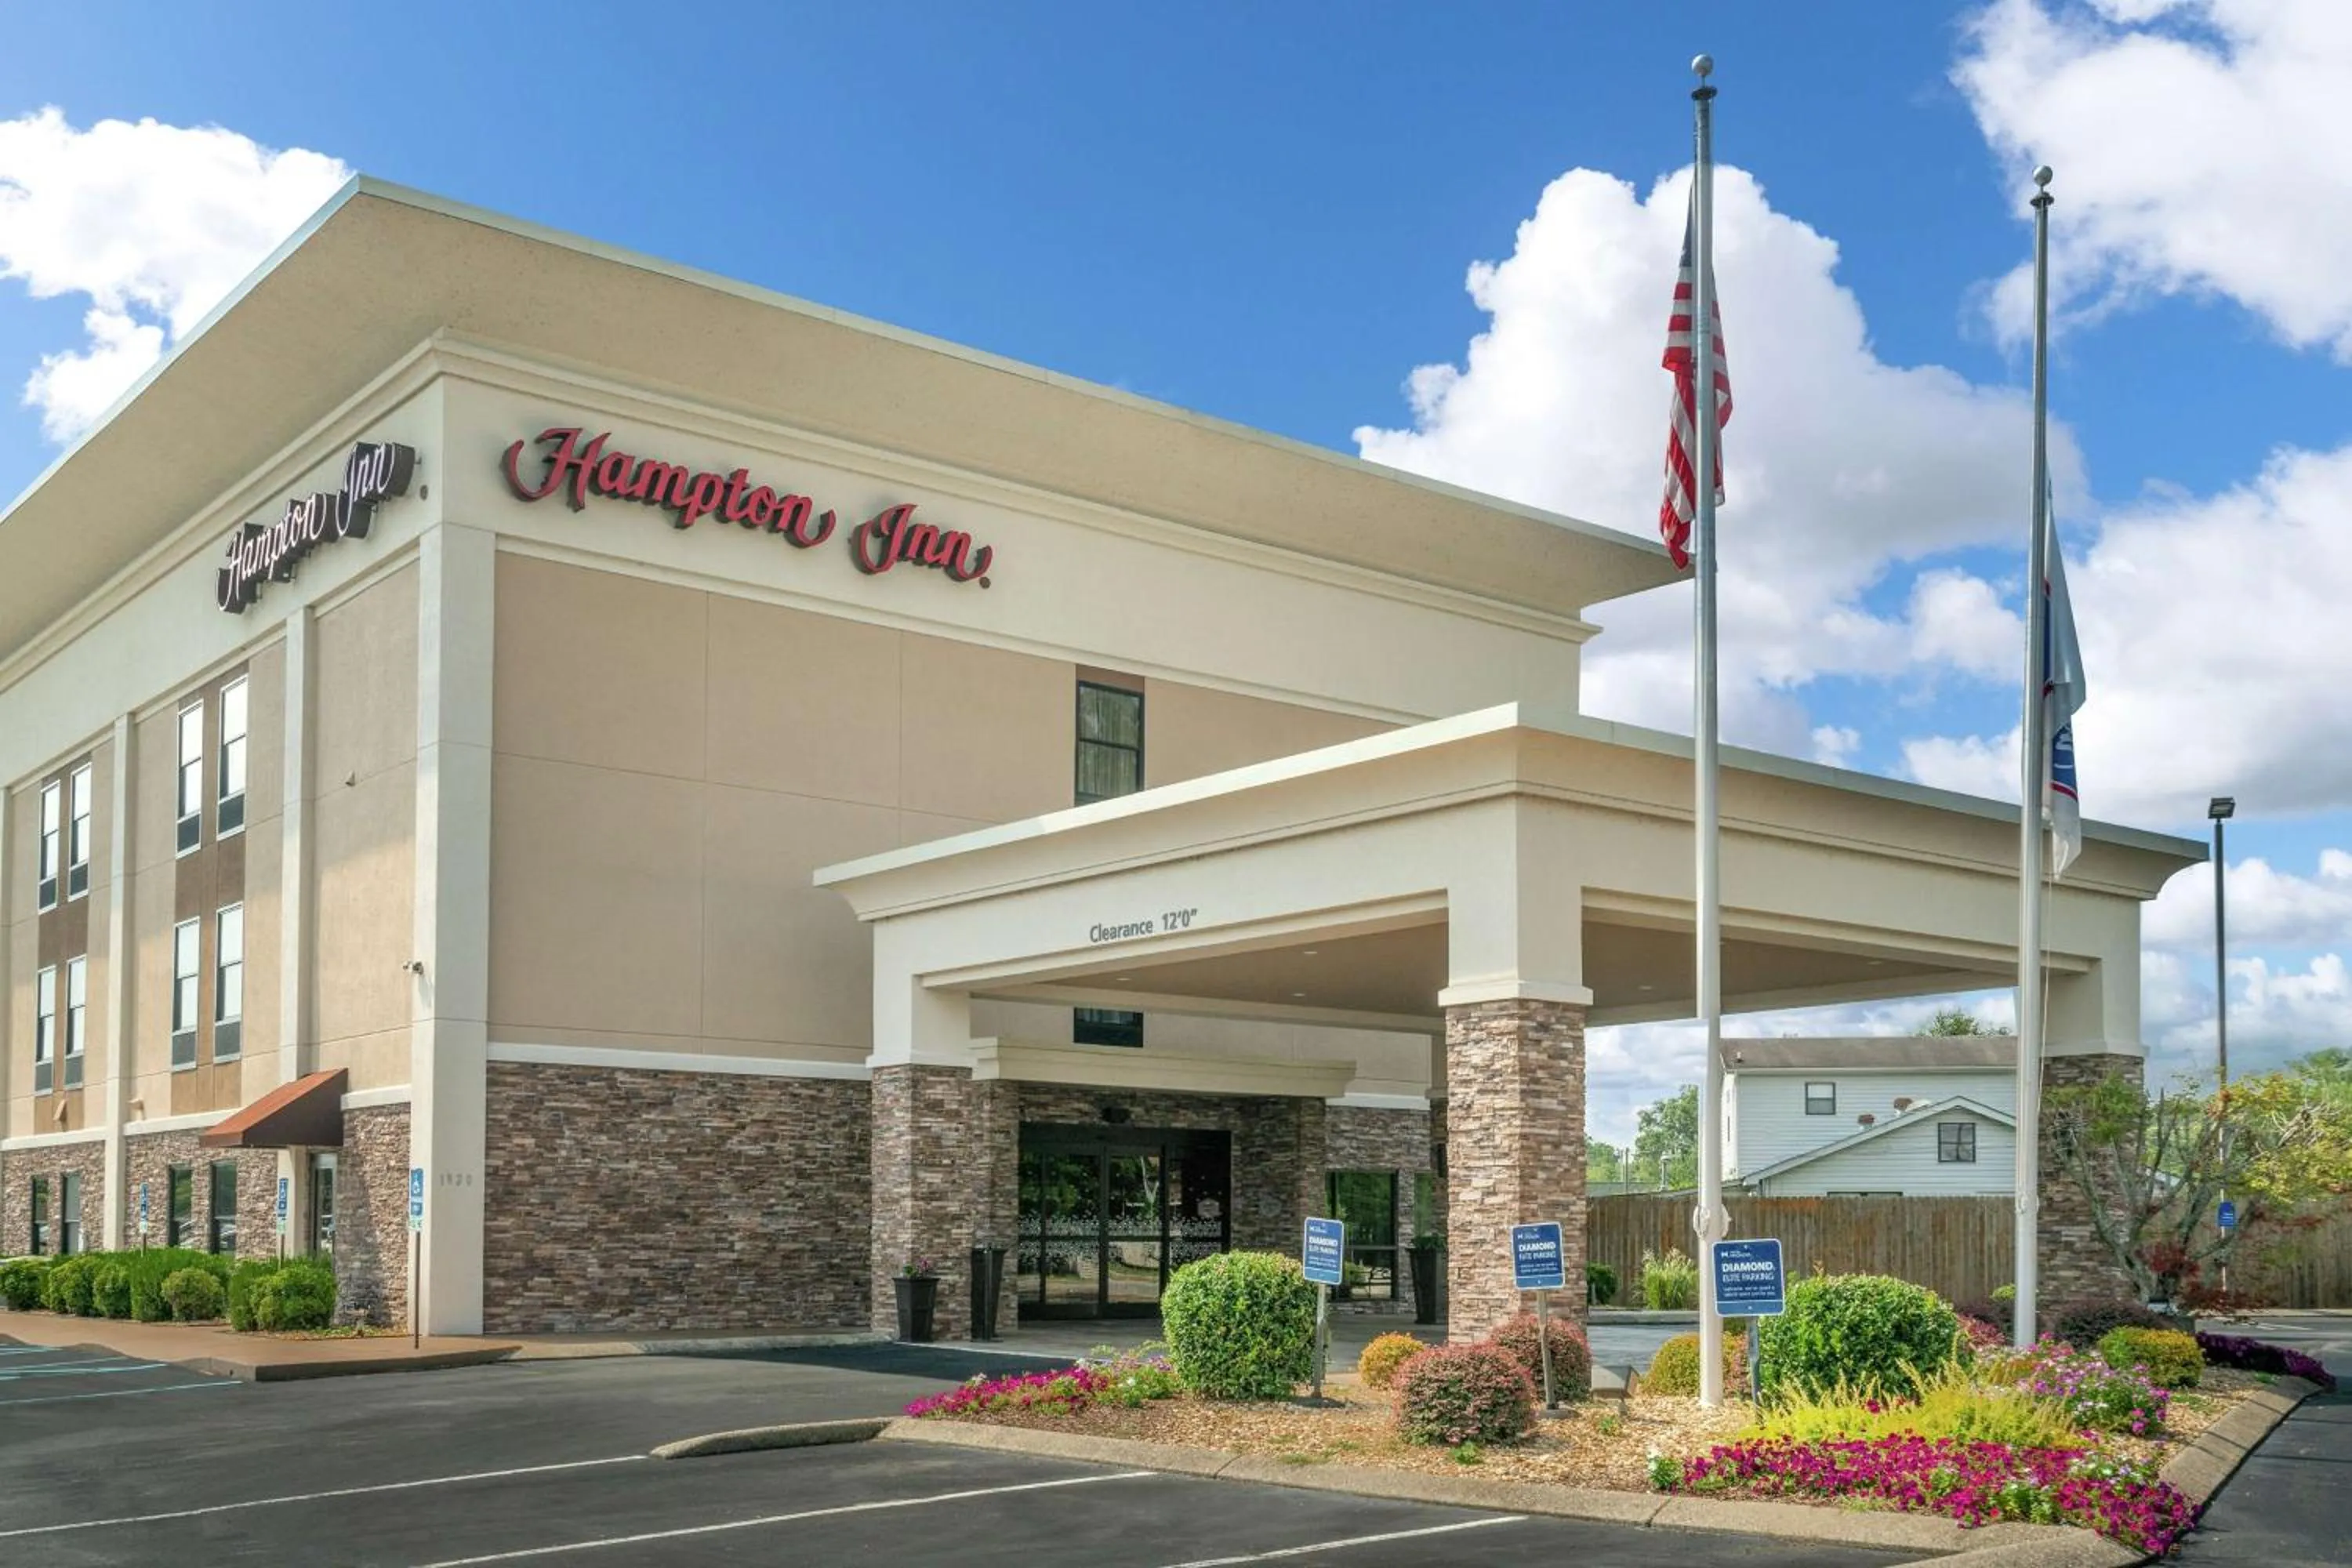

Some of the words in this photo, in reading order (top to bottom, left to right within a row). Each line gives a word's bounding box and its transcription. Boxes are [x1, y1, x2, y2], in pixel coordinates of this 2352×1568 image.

[215, 492, 329, 612] Hampton
[336, 441, 400, 537] Inn
[503, 426, 837, 548] Hampton
[1089, 921, 1154, 943] Clearance
